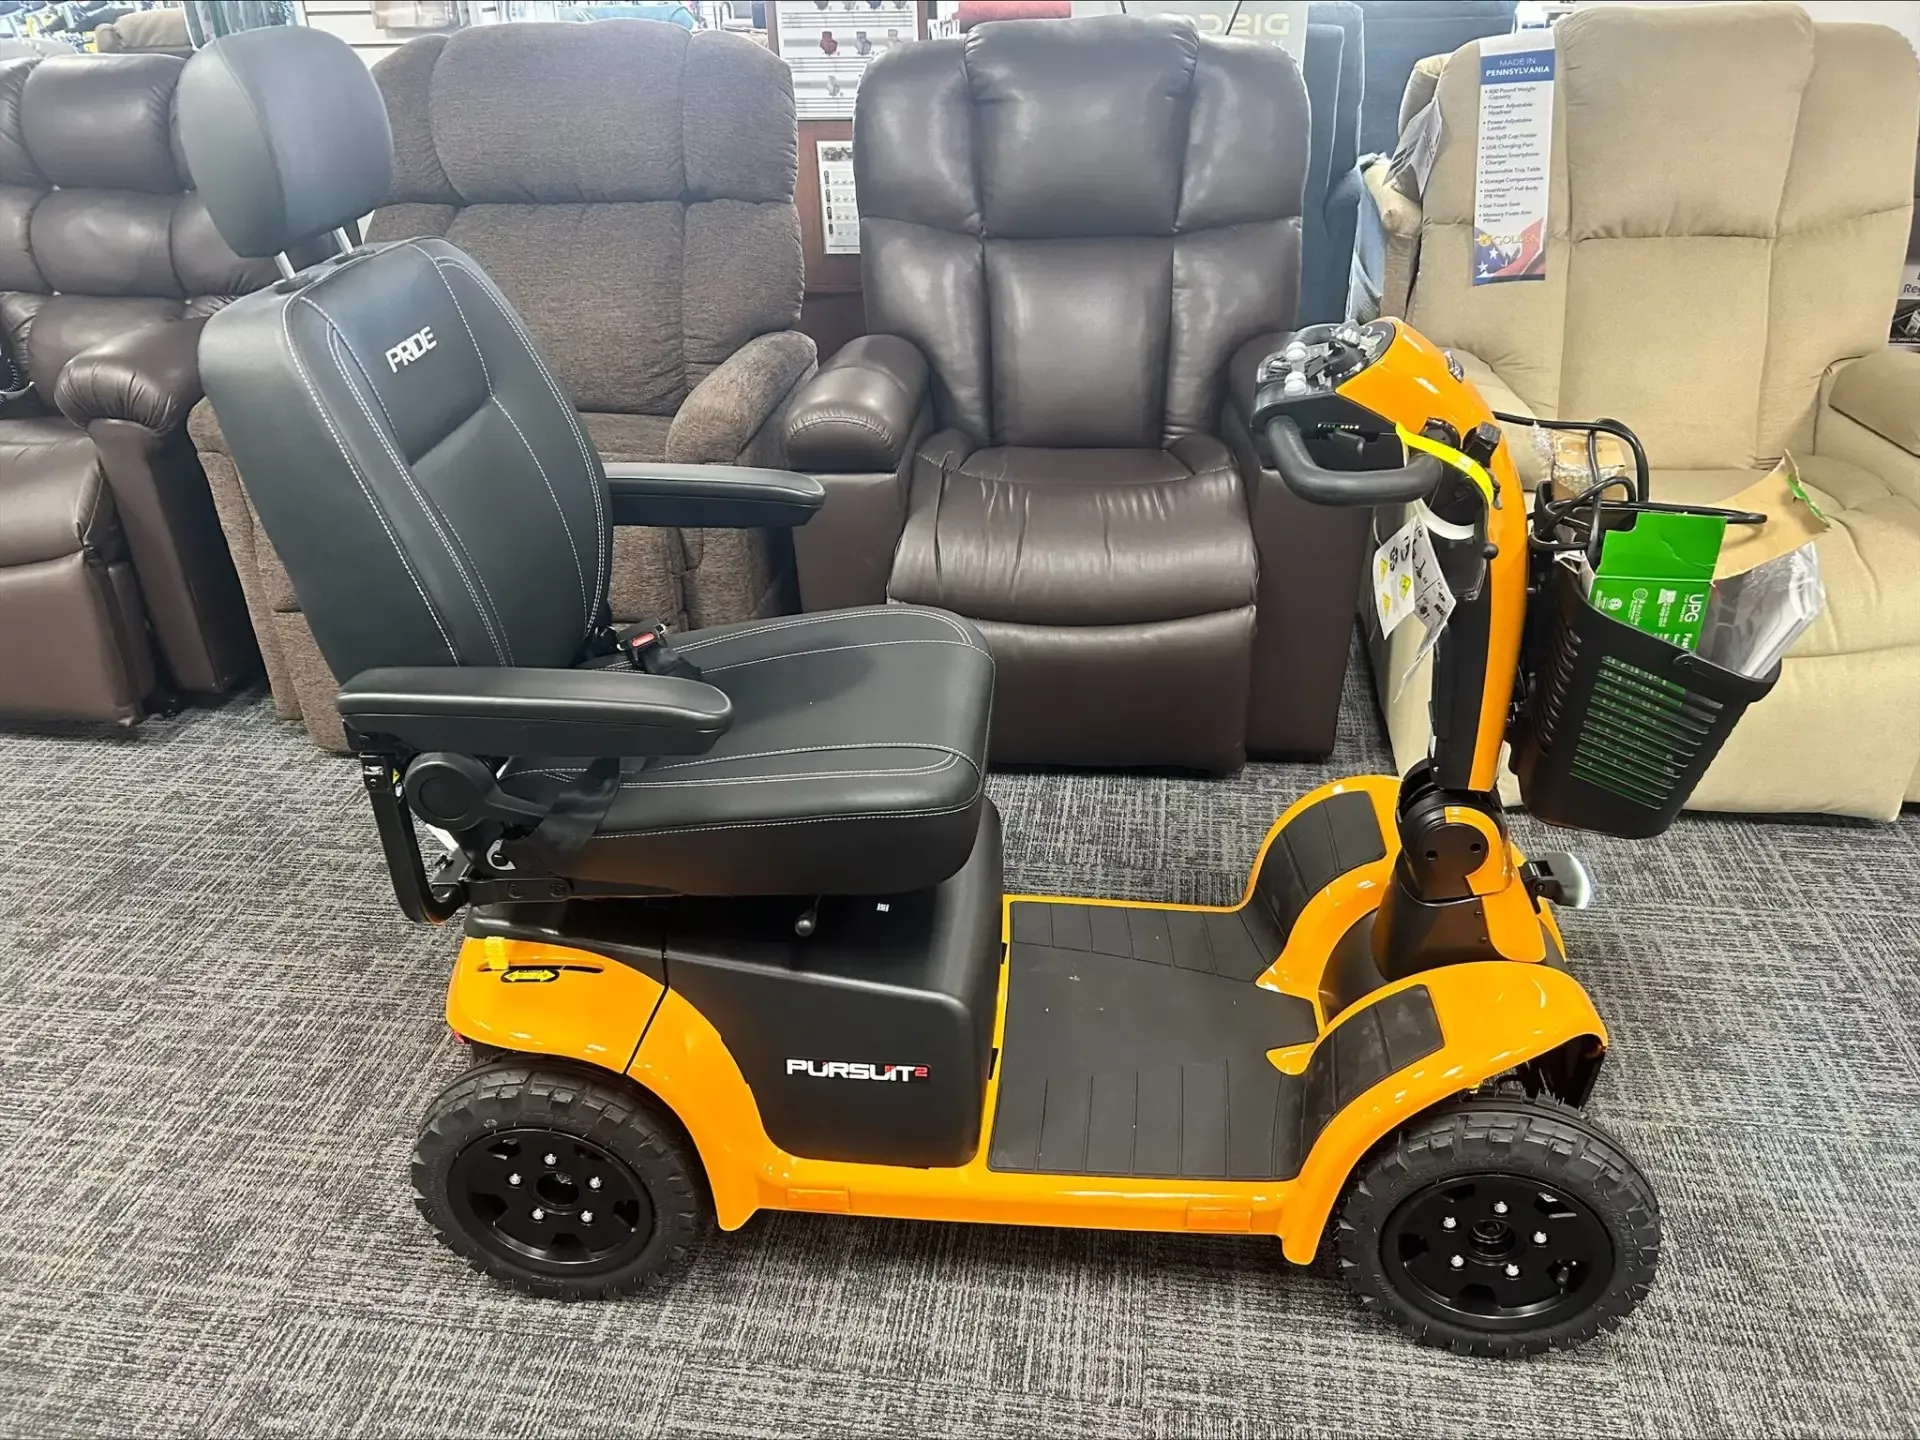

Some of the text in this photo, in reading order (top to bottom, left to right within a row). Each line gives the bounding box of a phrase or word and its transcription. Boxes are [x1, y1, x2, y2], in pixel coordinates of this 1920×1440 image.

[1499, 57, 1536, 67] MADE IN
[1485, 65, 1550, 77] PENNSYLVANIA
[1904, 283, 1920, 296] Re
[385, 326, 437, 373] PRIDE
[1684, 594, 1704, 623] UPG
